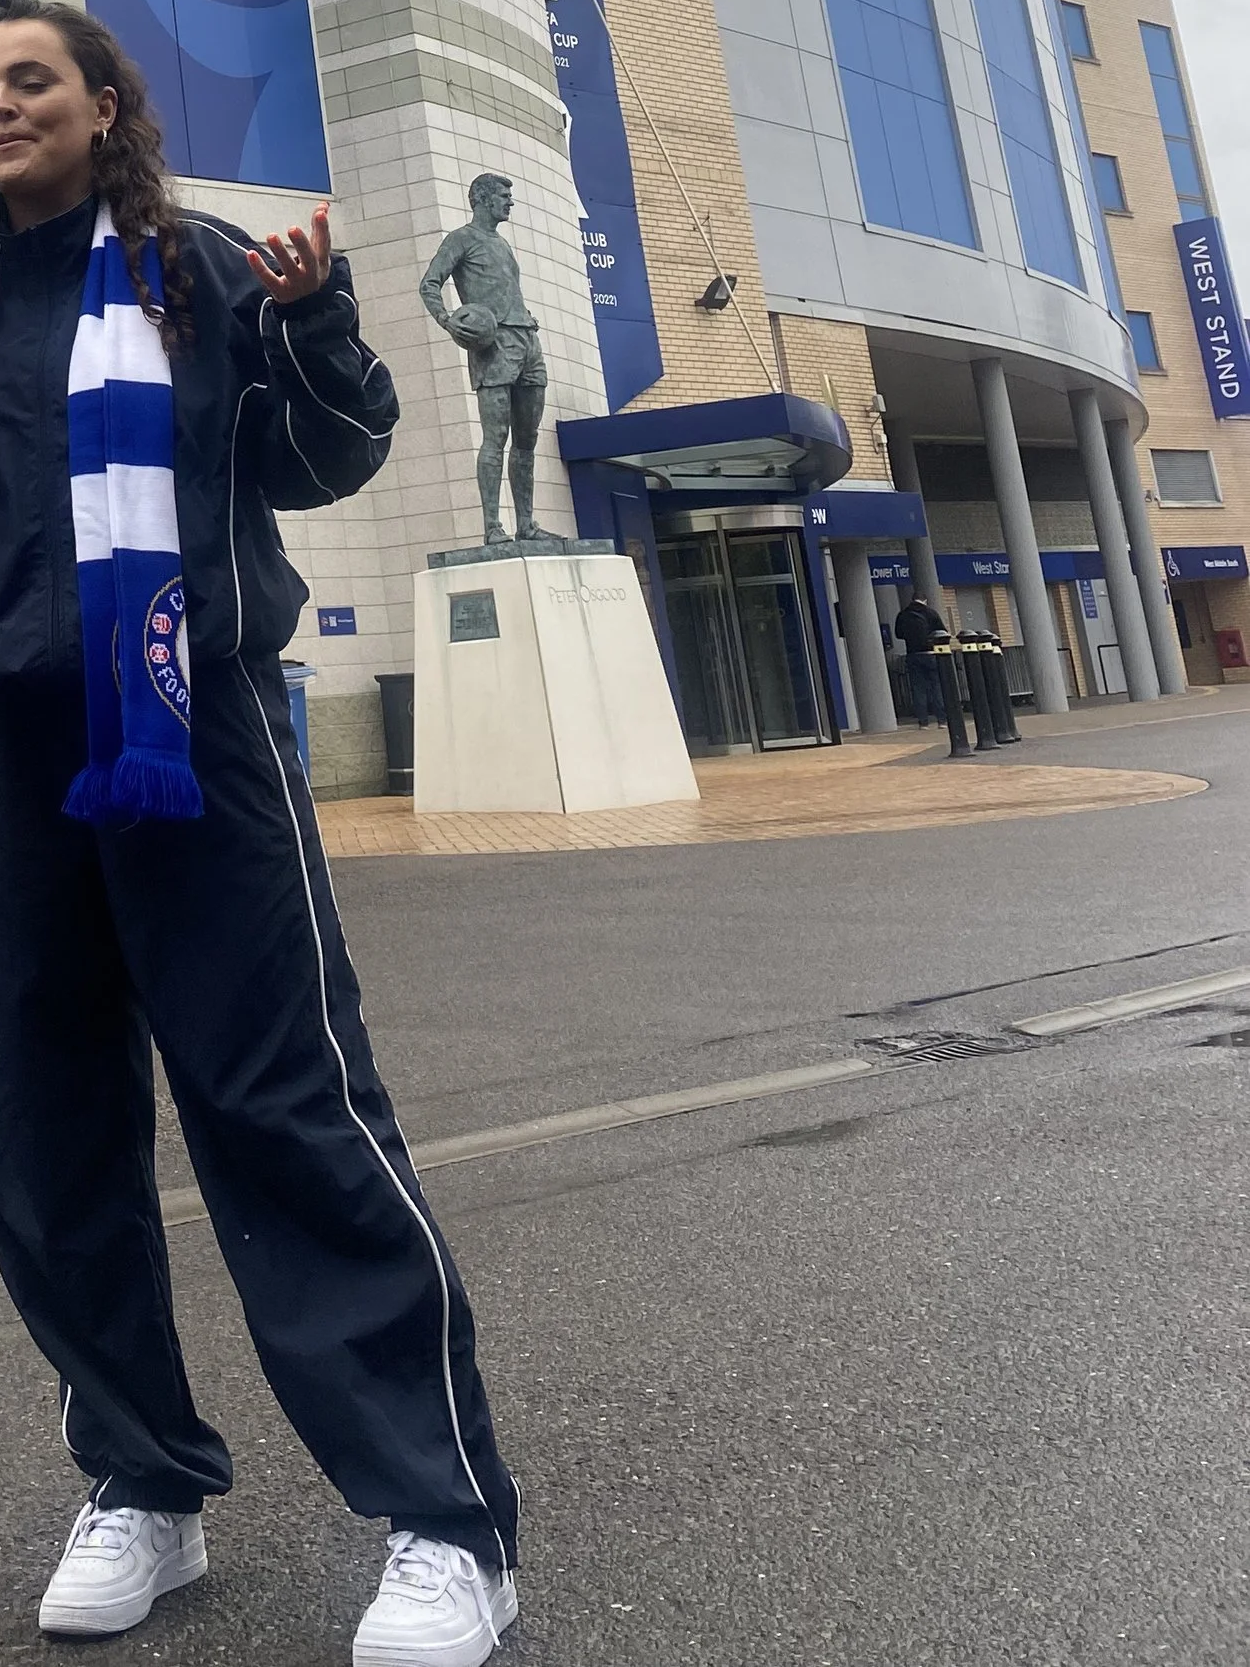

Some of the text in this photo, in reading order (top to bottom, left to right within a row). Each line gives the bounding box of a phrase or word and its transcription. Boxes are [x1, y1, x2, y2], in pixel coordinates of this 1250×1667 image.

[553, 32, 579, 49] CUP
[554, 55, 570, 68] 021
[590, 253, 616, 269] CUP
[593, 293, 618, 307] 2022)
[1187, 236, 1241, 400] WEST STAND
[972, 560, 1010, 575] West Sta
[548, 584, 627, 605] PETER OSGOOD
